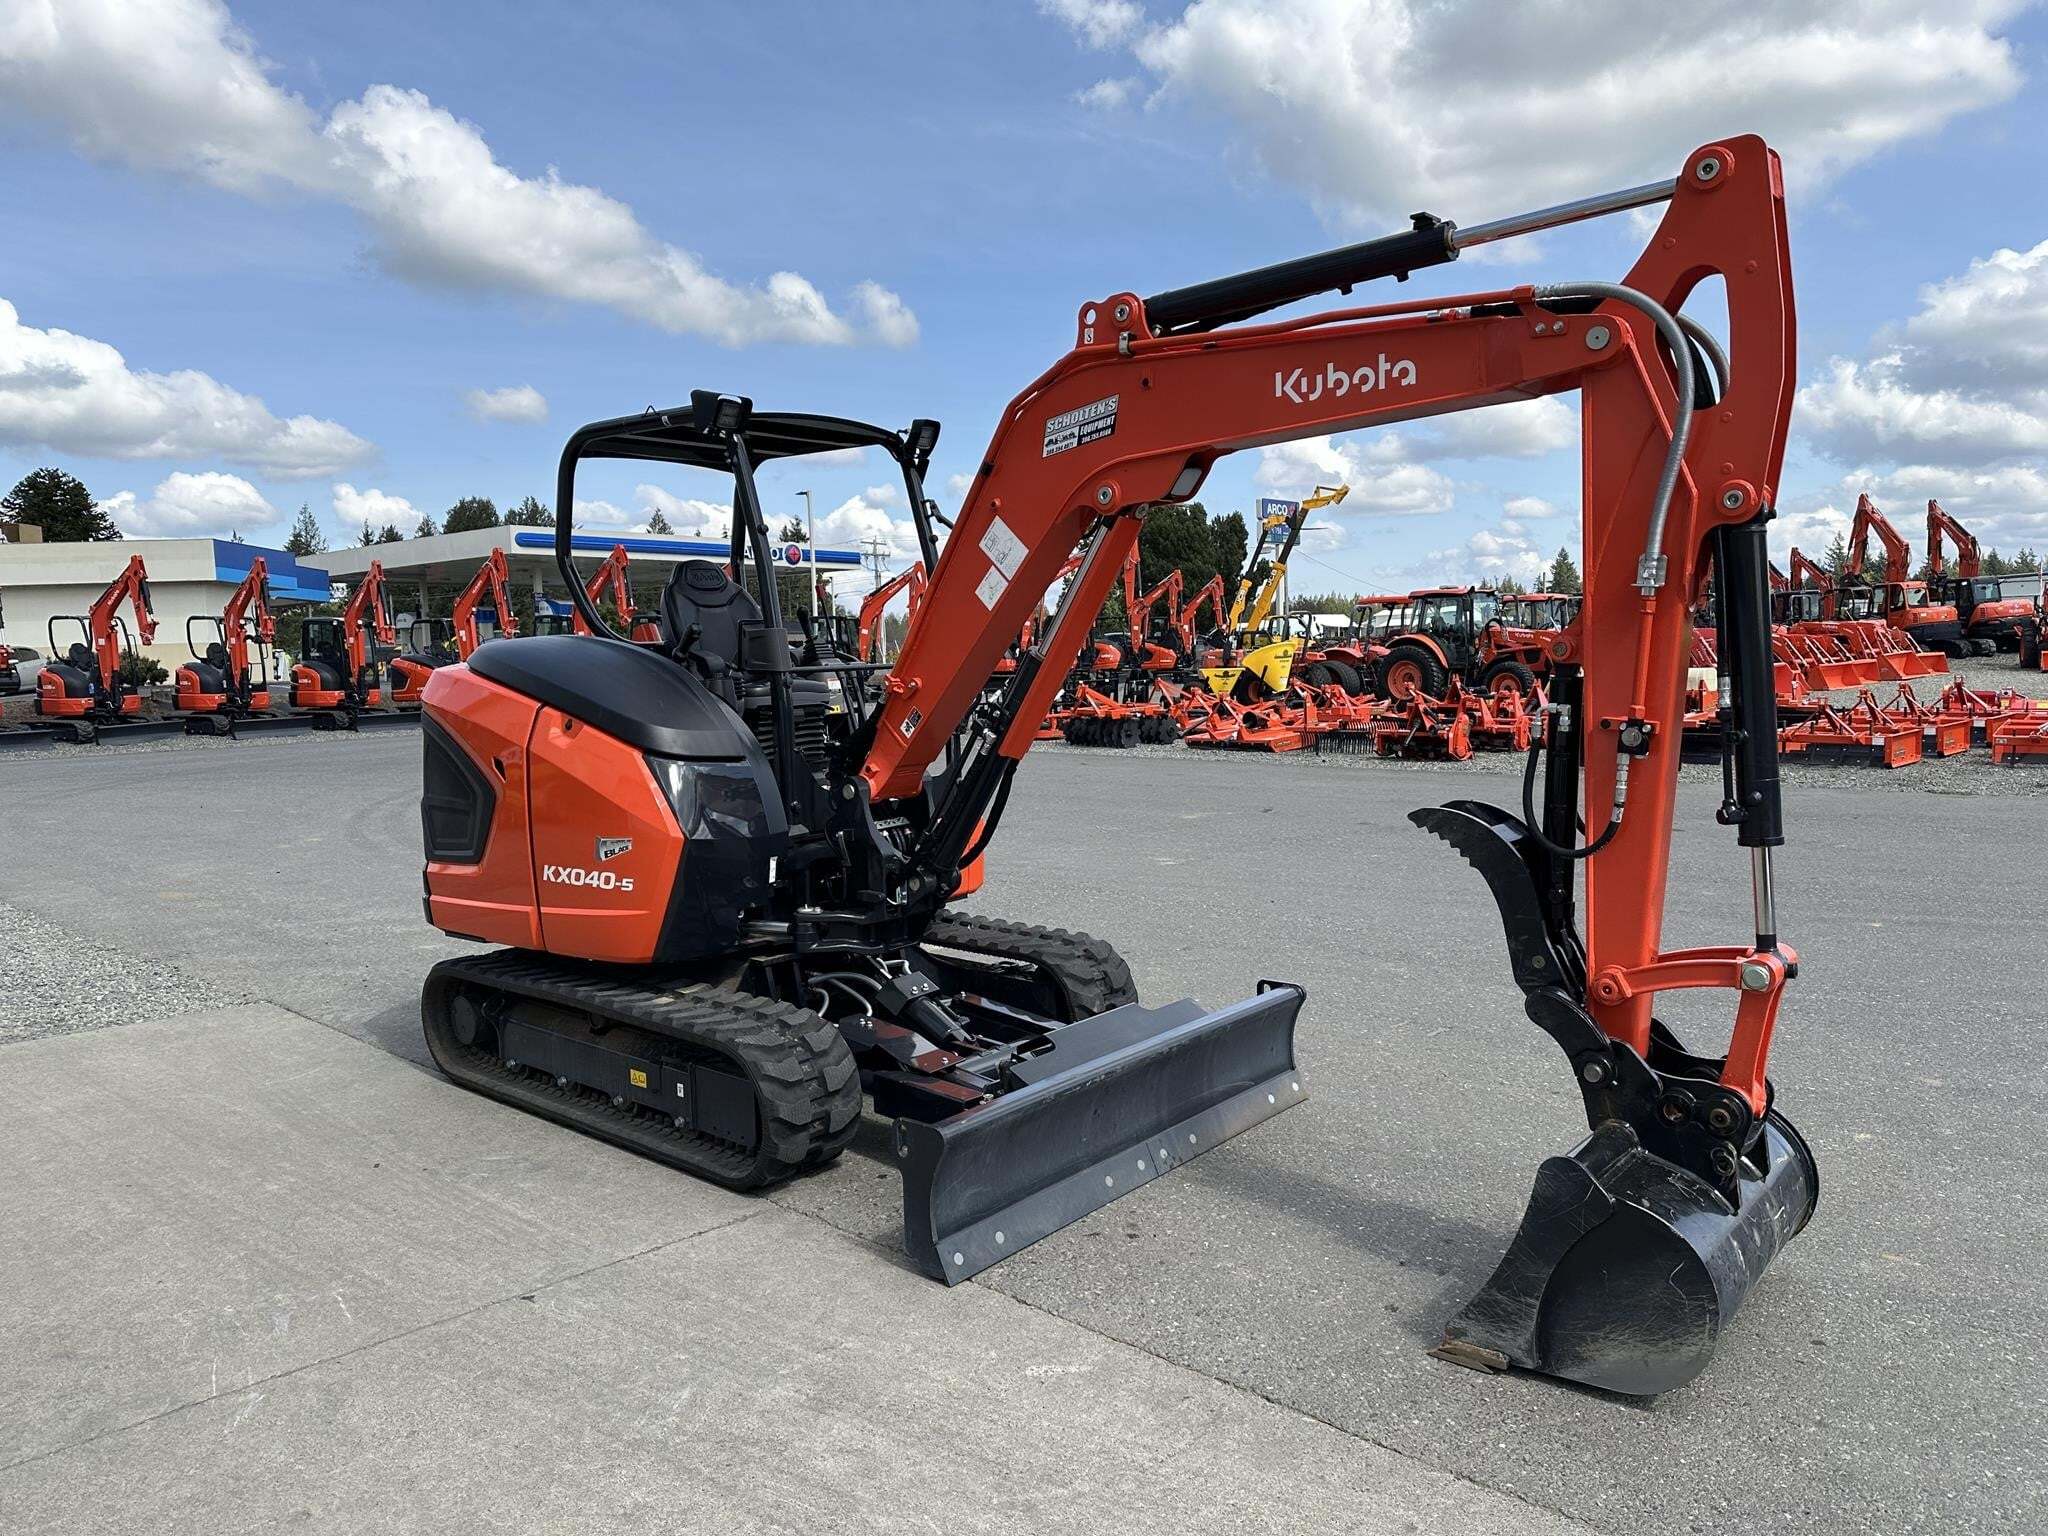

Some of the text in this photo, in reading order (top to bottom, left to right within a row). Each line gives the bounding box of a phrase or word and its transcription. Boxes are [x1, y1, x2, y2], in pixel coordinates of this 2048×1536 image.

[1275, 353, 1416, 403] Kubota
[1047, 398, 1117, 432] SCHOLTEN'S
[1080, 415, 1115, 435] EQUIPMENT
[1266, 503, 1288, 515] ARCO
[743, 547, 780, 560] AO
[542, 864, 635, 891] KX040-5
